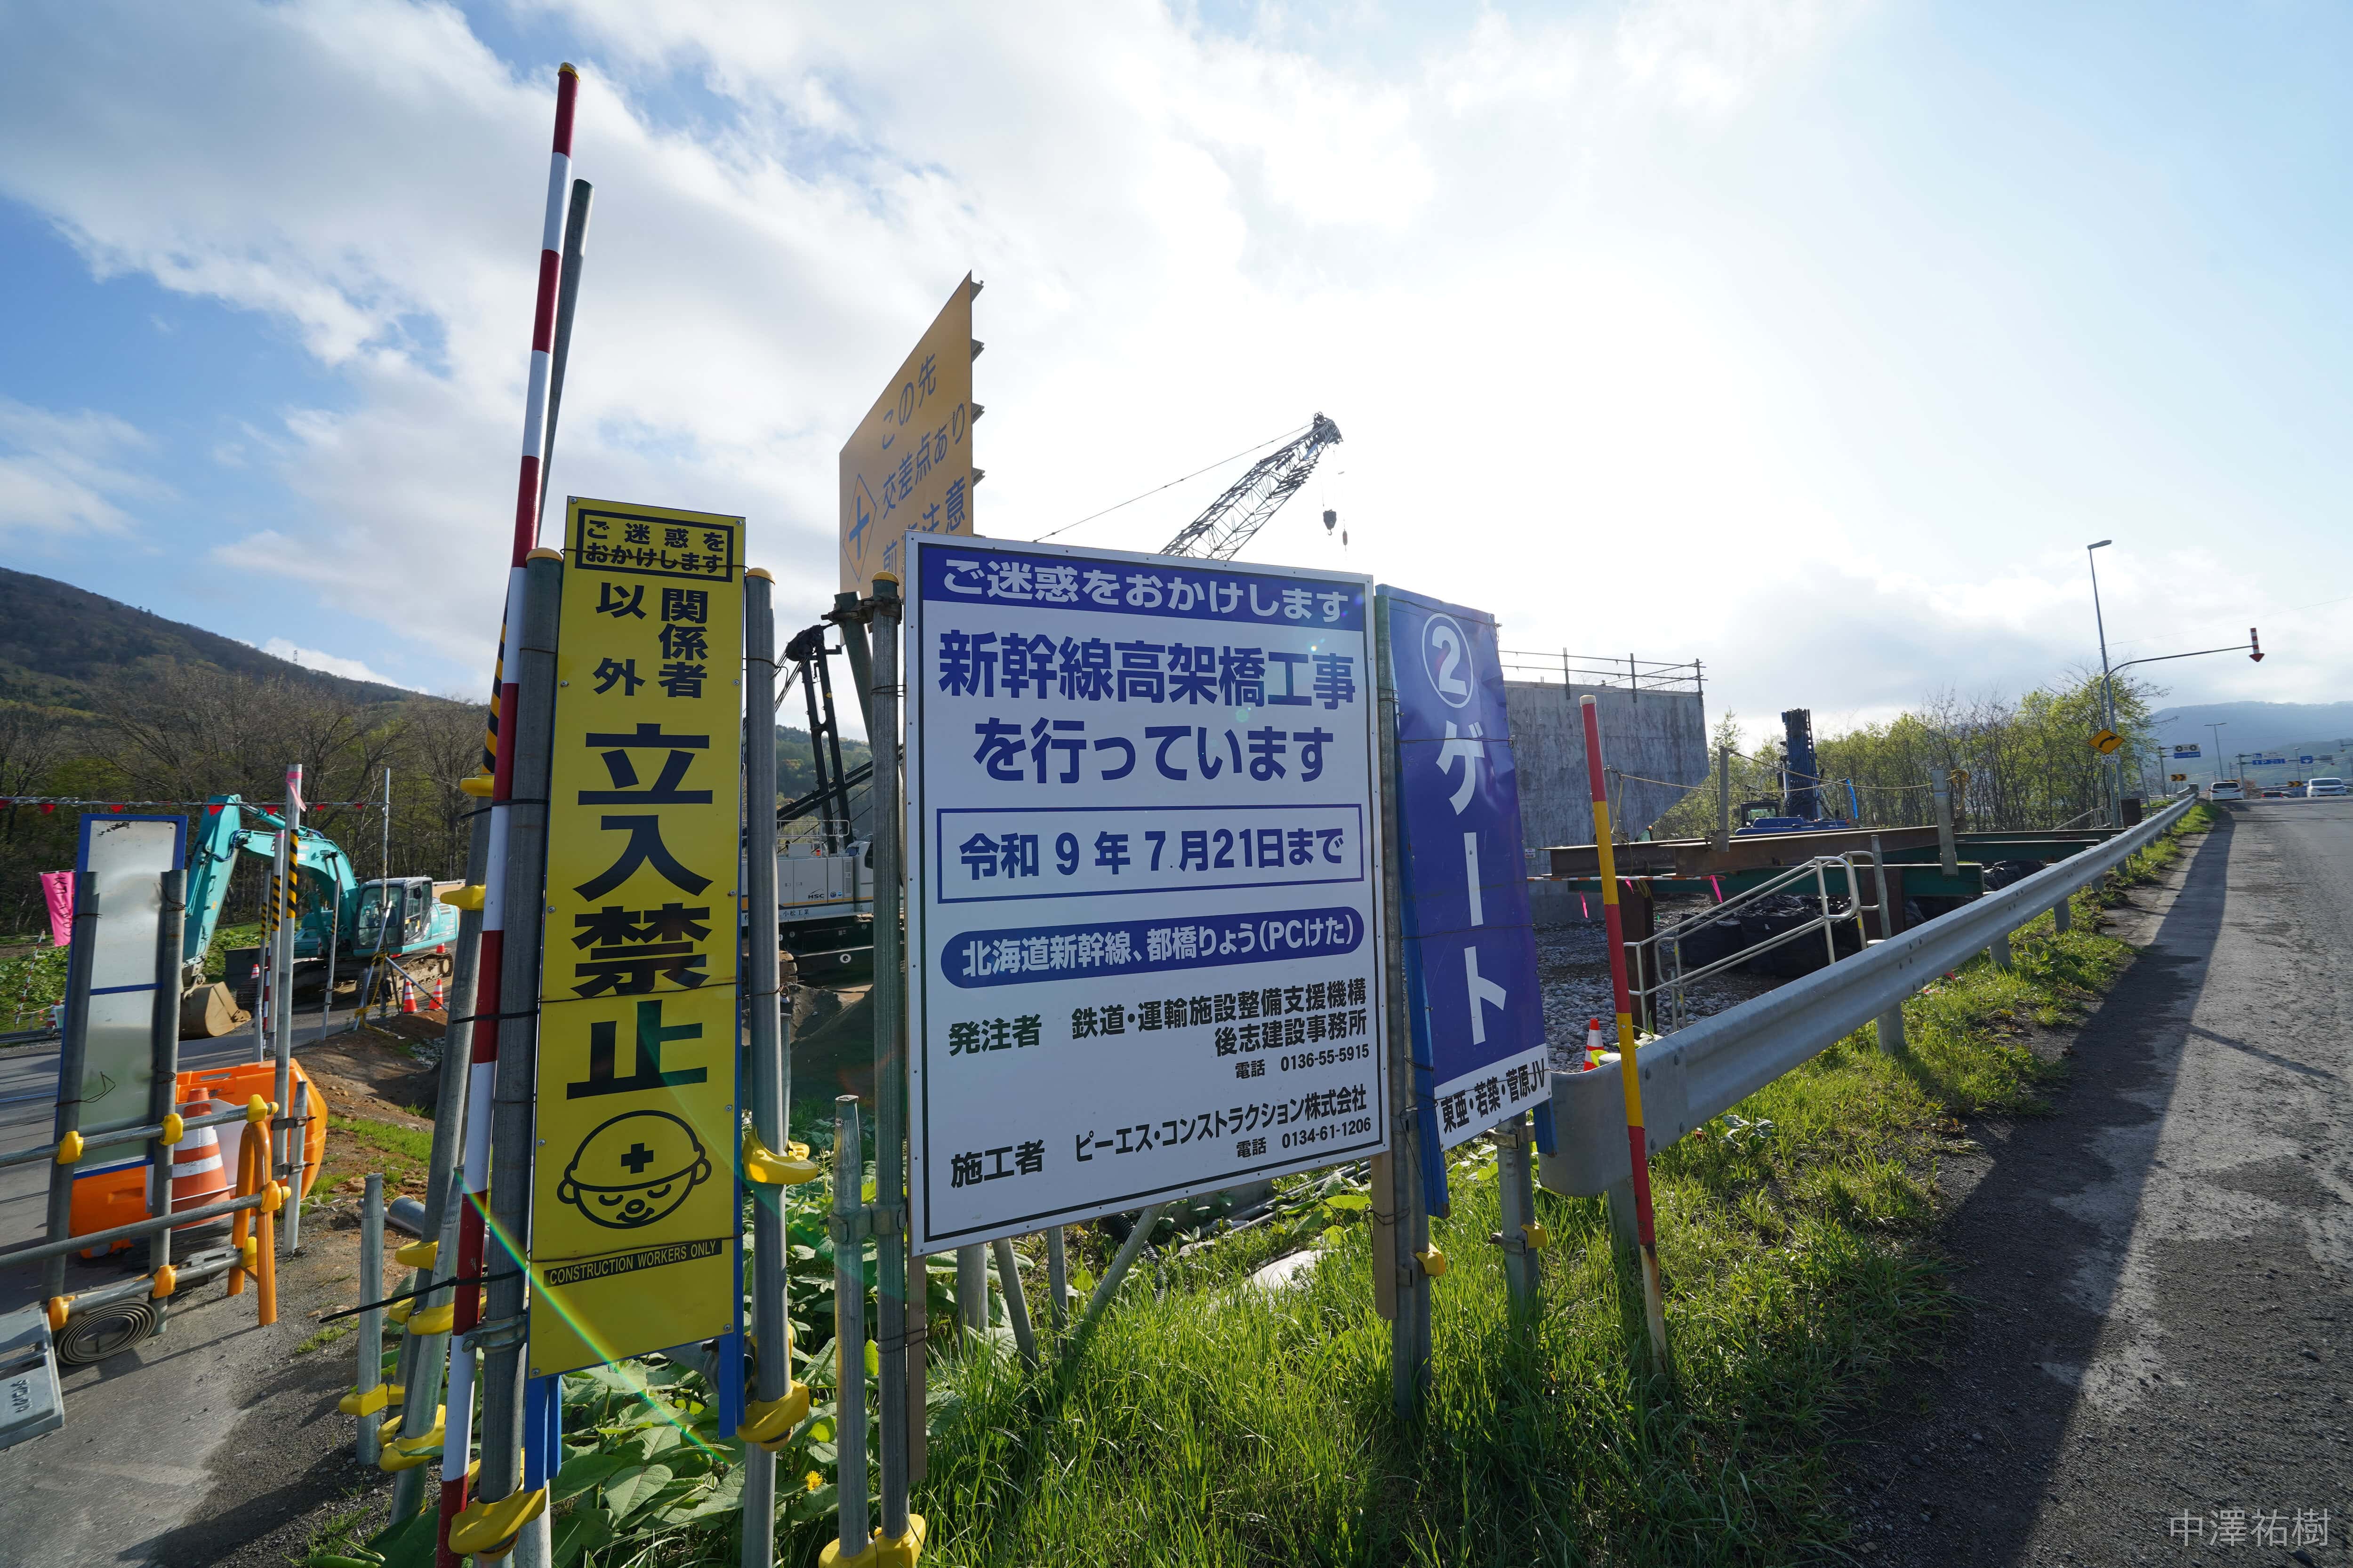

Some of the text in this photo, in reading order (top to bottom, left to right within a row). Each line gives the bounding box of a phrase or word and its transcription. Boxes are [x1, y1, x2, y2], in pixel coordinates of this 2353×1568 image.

[883, 353, 936, 450] この先
[883, 403, 964, 520] 交差点あり
[586, 543, 723, 573] おかけします
[587, 520, 725, 552] ご迷惑を
[943, 559, 1349, 623] ご迷惑をおかけします
[593, 582, 647, 696] 以外
[658, 588, 708, 698] 関係者
[938, 629, 1356, 710] 新幹線高架橋工事
[973, 717, 1334, 784] を行っています
[567, 723, 714, 1100] 立入禁止
[948, 977, 1366, 1056] 発注者 鉄道・運輸施設整備支援機構
[1214, 1008, 1367, 1057] 後志建設事務所
[1235, 1043, 1369, 1080] 電話 0136-55-5915
[1440, 1057, 1545, 1134] 東亜・若築・菅原JV
[950, 1083, 1366, 1188] 施工者 ピーエス・コンストラクション株式会社
[1236, 1117, 1371, 1158] 電話 0134-61-1206
[549, 1240, 716, 1285] CONSTRUCTION WORKERS ONLY
